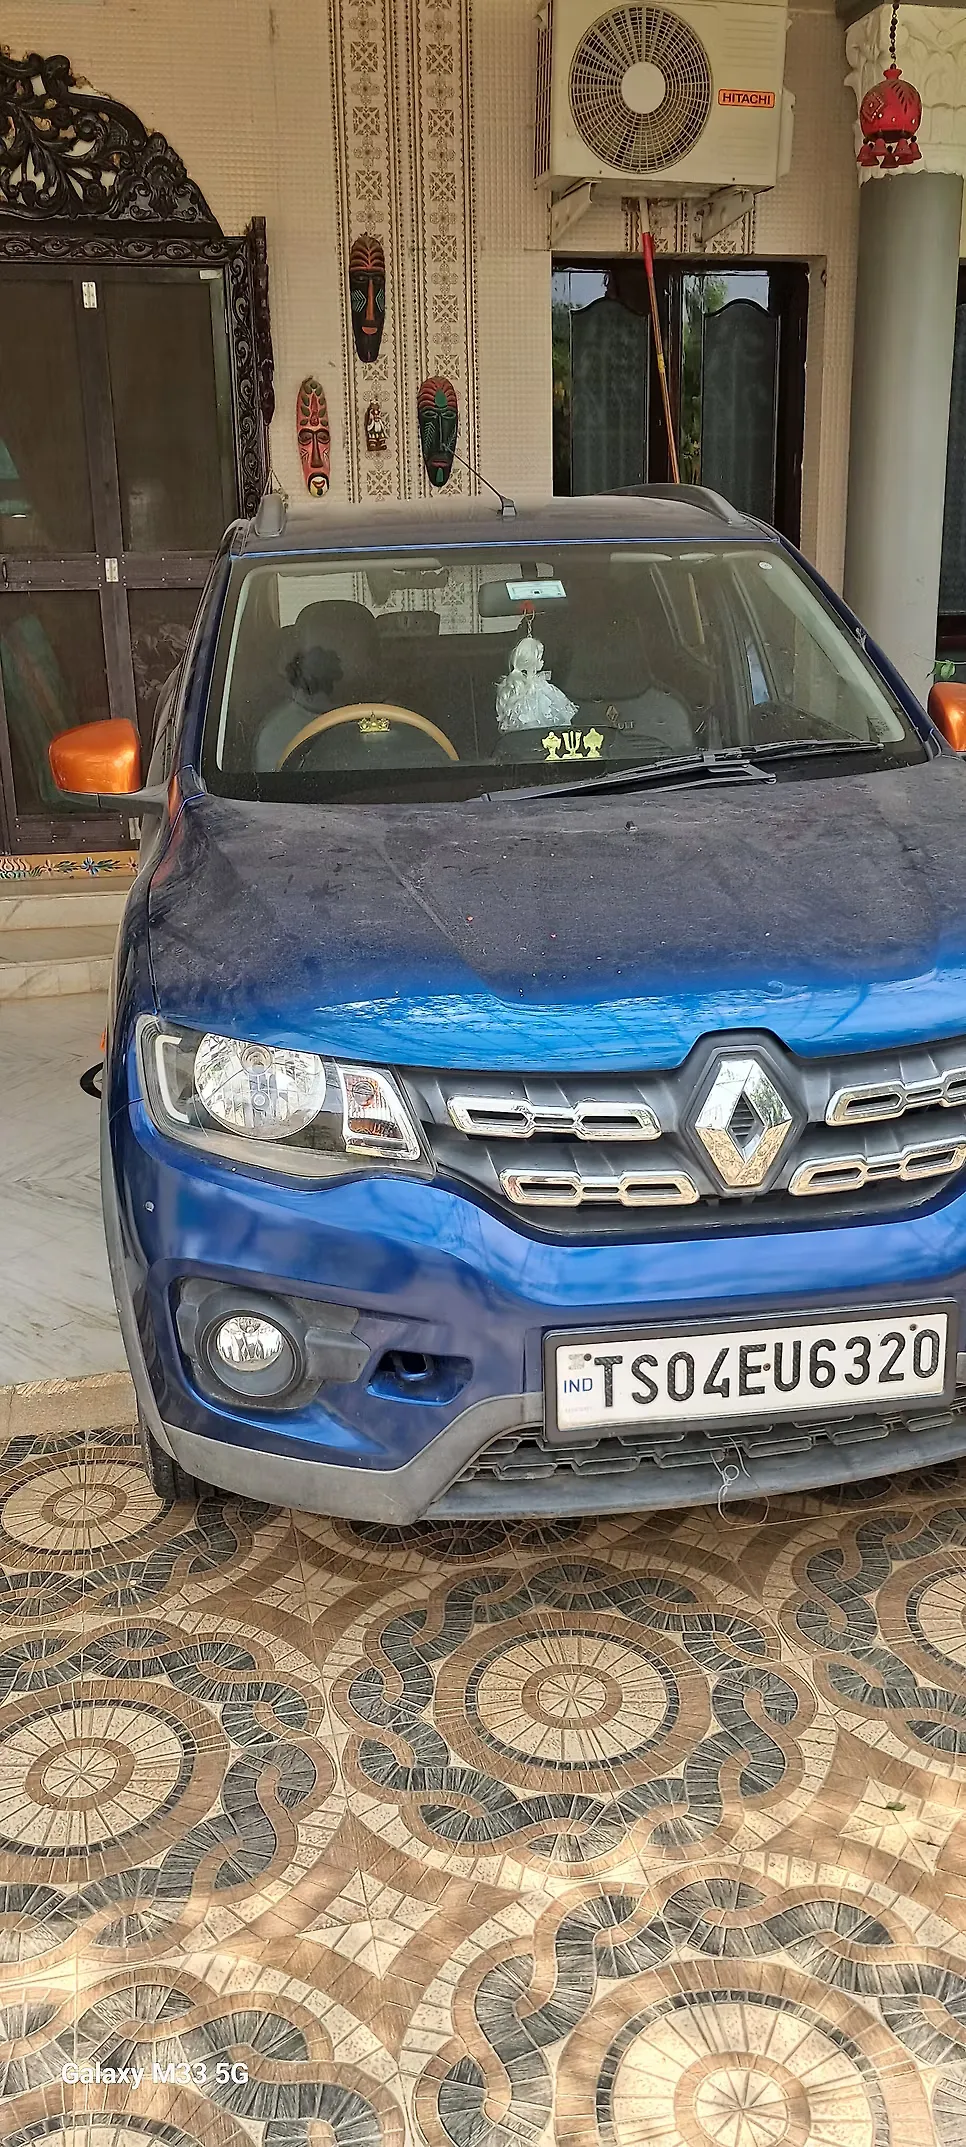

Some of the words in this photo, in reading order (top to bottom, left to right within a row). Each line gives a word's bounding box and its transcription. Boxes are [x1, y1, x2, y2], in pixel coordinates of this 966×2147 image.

[722, 93, 770, 104] HITACHI
[594, 1329, 940, 1407] TS04EU6320
[564, 1377, 593, 1394] IND
